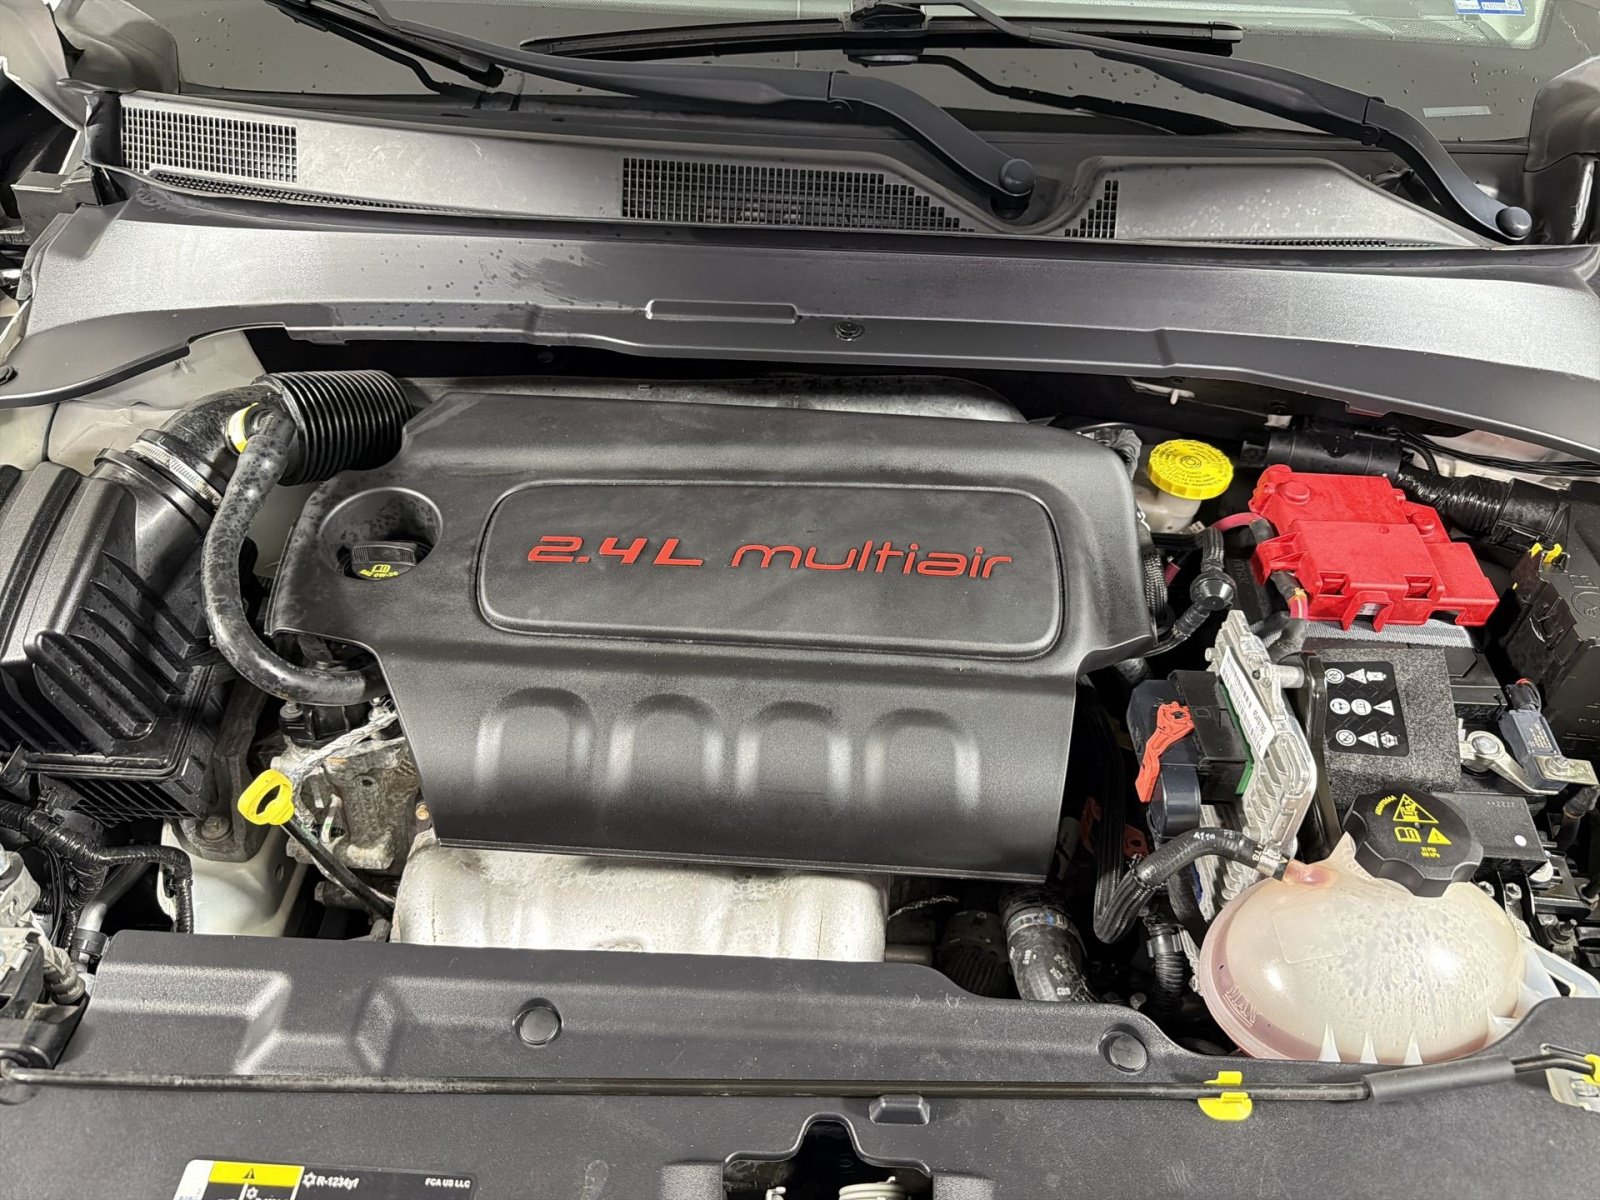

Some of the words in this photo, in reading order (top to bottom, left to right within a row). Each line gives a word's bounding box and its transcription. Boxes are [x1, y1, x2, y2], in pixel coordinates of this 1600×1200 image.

[732, 540, 1012, 578] multiair
[316, 1175, 360, 1191] R-1234yf
[424, 1177, 442, 1187] FCA
[442, 1178, 455, 1188] US
[455, 1179, 471, 1189] LLC
